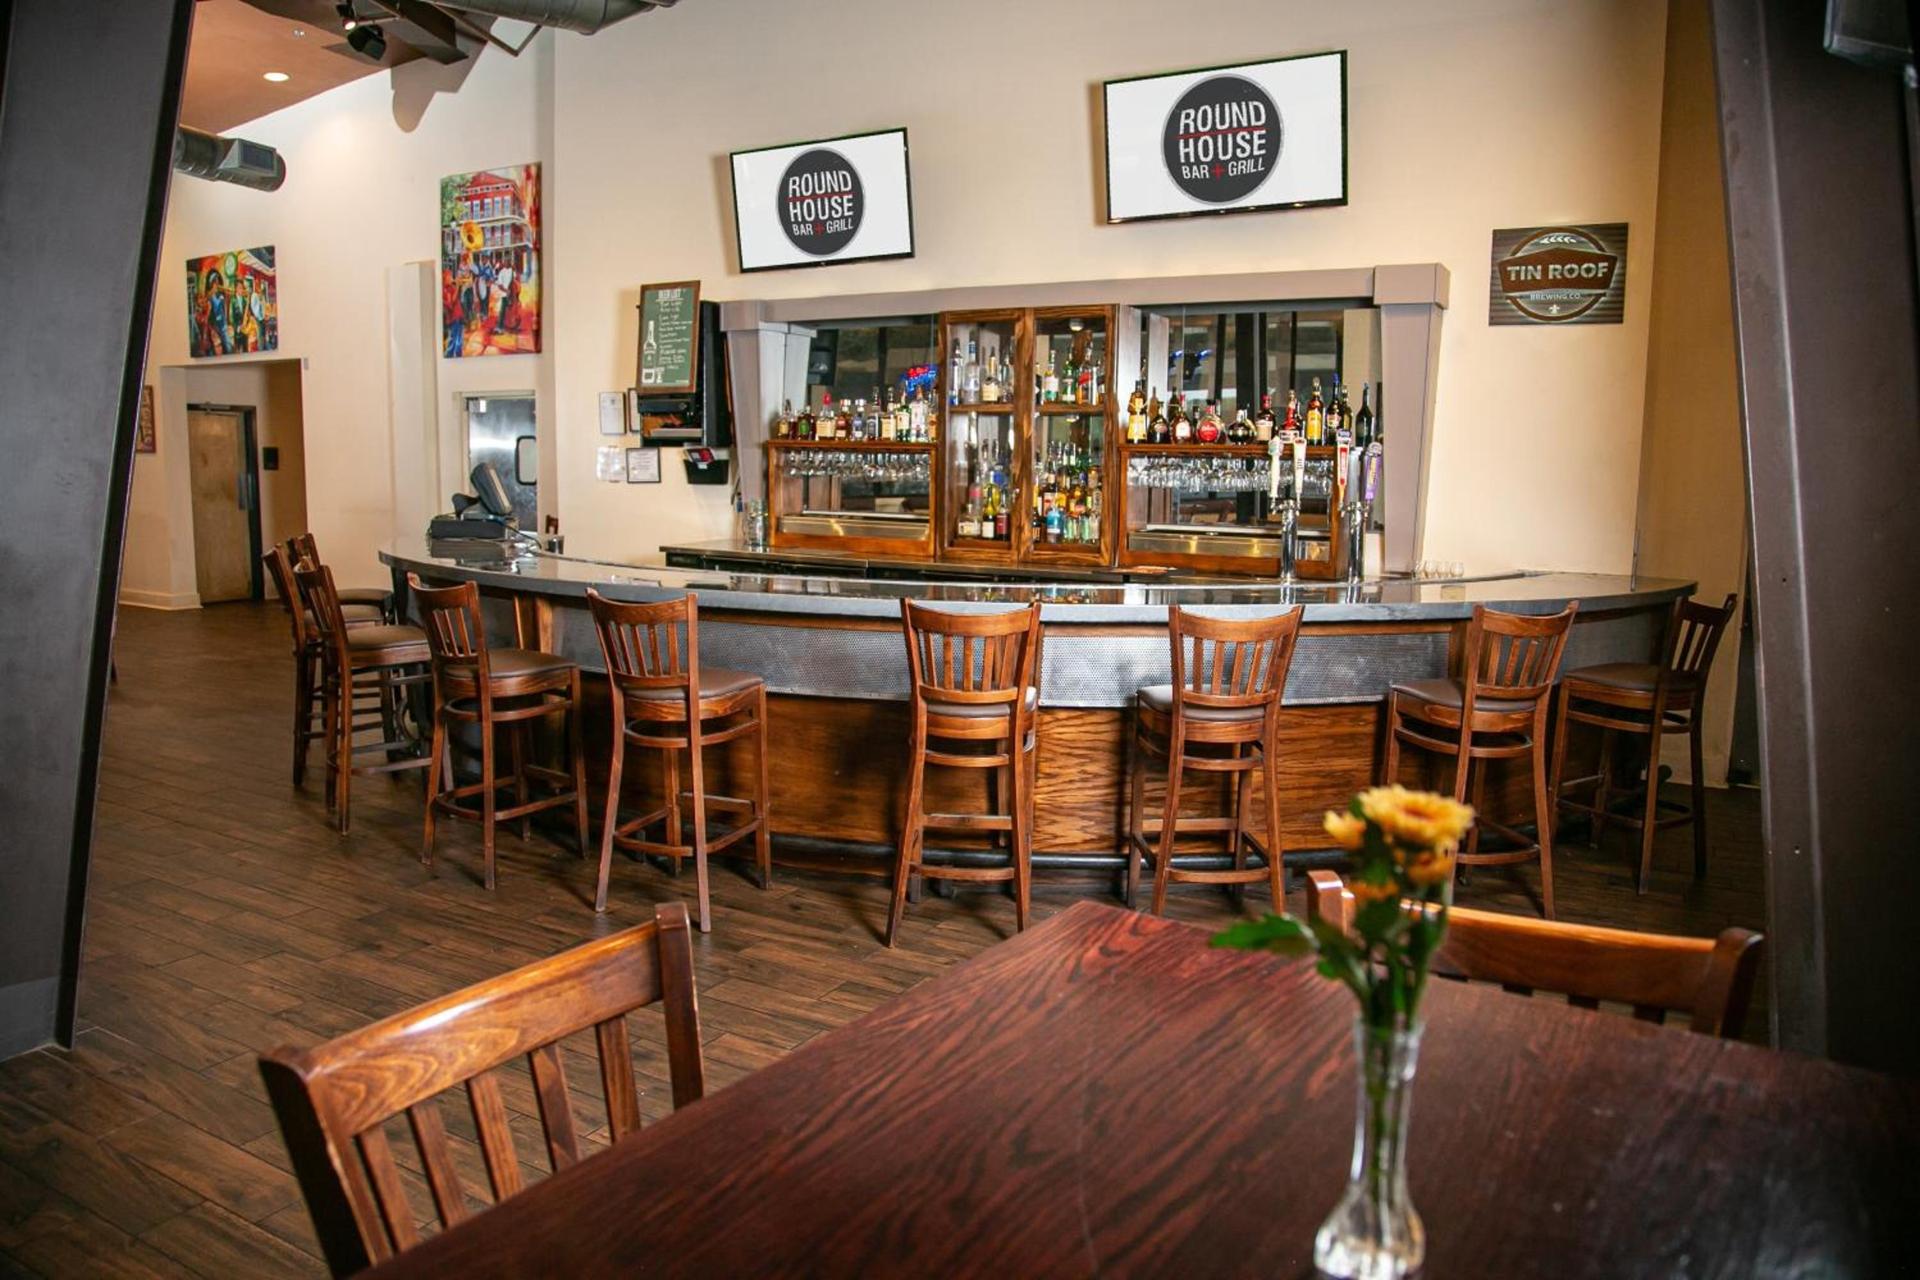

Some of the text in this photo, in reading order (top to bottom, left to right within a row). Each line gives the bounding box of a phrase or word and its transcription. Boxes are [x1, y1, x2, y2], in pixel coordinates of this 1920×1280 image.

[1179, 101, 1266, 134] ROUND
[1179, 130, 1266, 163] HOUSE
[1182, 165, 1209, 179] BAR
[1228, 157, 1265, 177] GRILL
[788, 170, 852, 197] ROUND
[789, 195, 853, 222] HOUSE
[792, 223, 813, 235] BAR
[826, 219, 853, 233] GRILL
[1506, 262, 1609, 281] TIN ROOF
